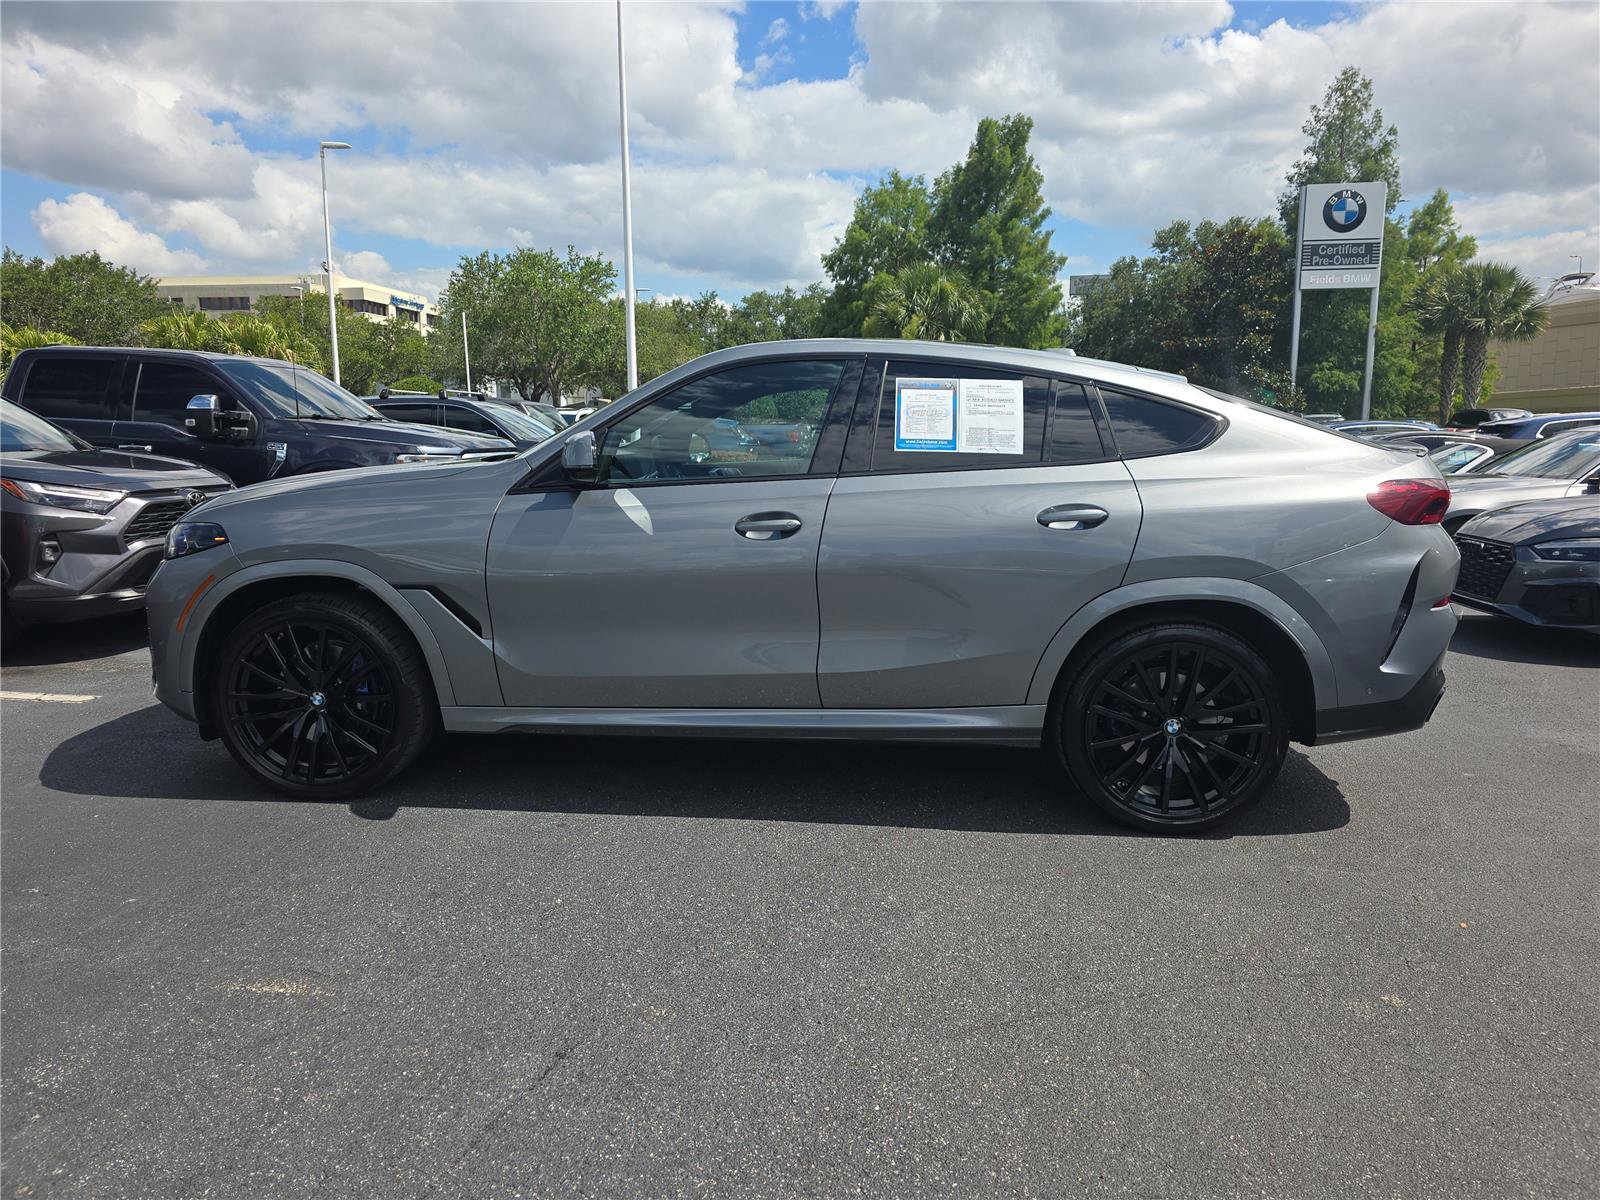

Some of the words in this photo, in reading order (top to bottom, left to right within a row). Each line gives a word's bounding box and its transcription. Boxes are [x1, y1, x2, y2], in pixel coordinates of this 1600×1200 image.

[1328, 190, 1364, 205] BMW
[1319, 244, 1365, 255] Certified
[1312, 255, 1370, 266] Pre-Owned
[1310, 275, 1341, 284] Fields
[1343, 274, 1371, 283] BMW
